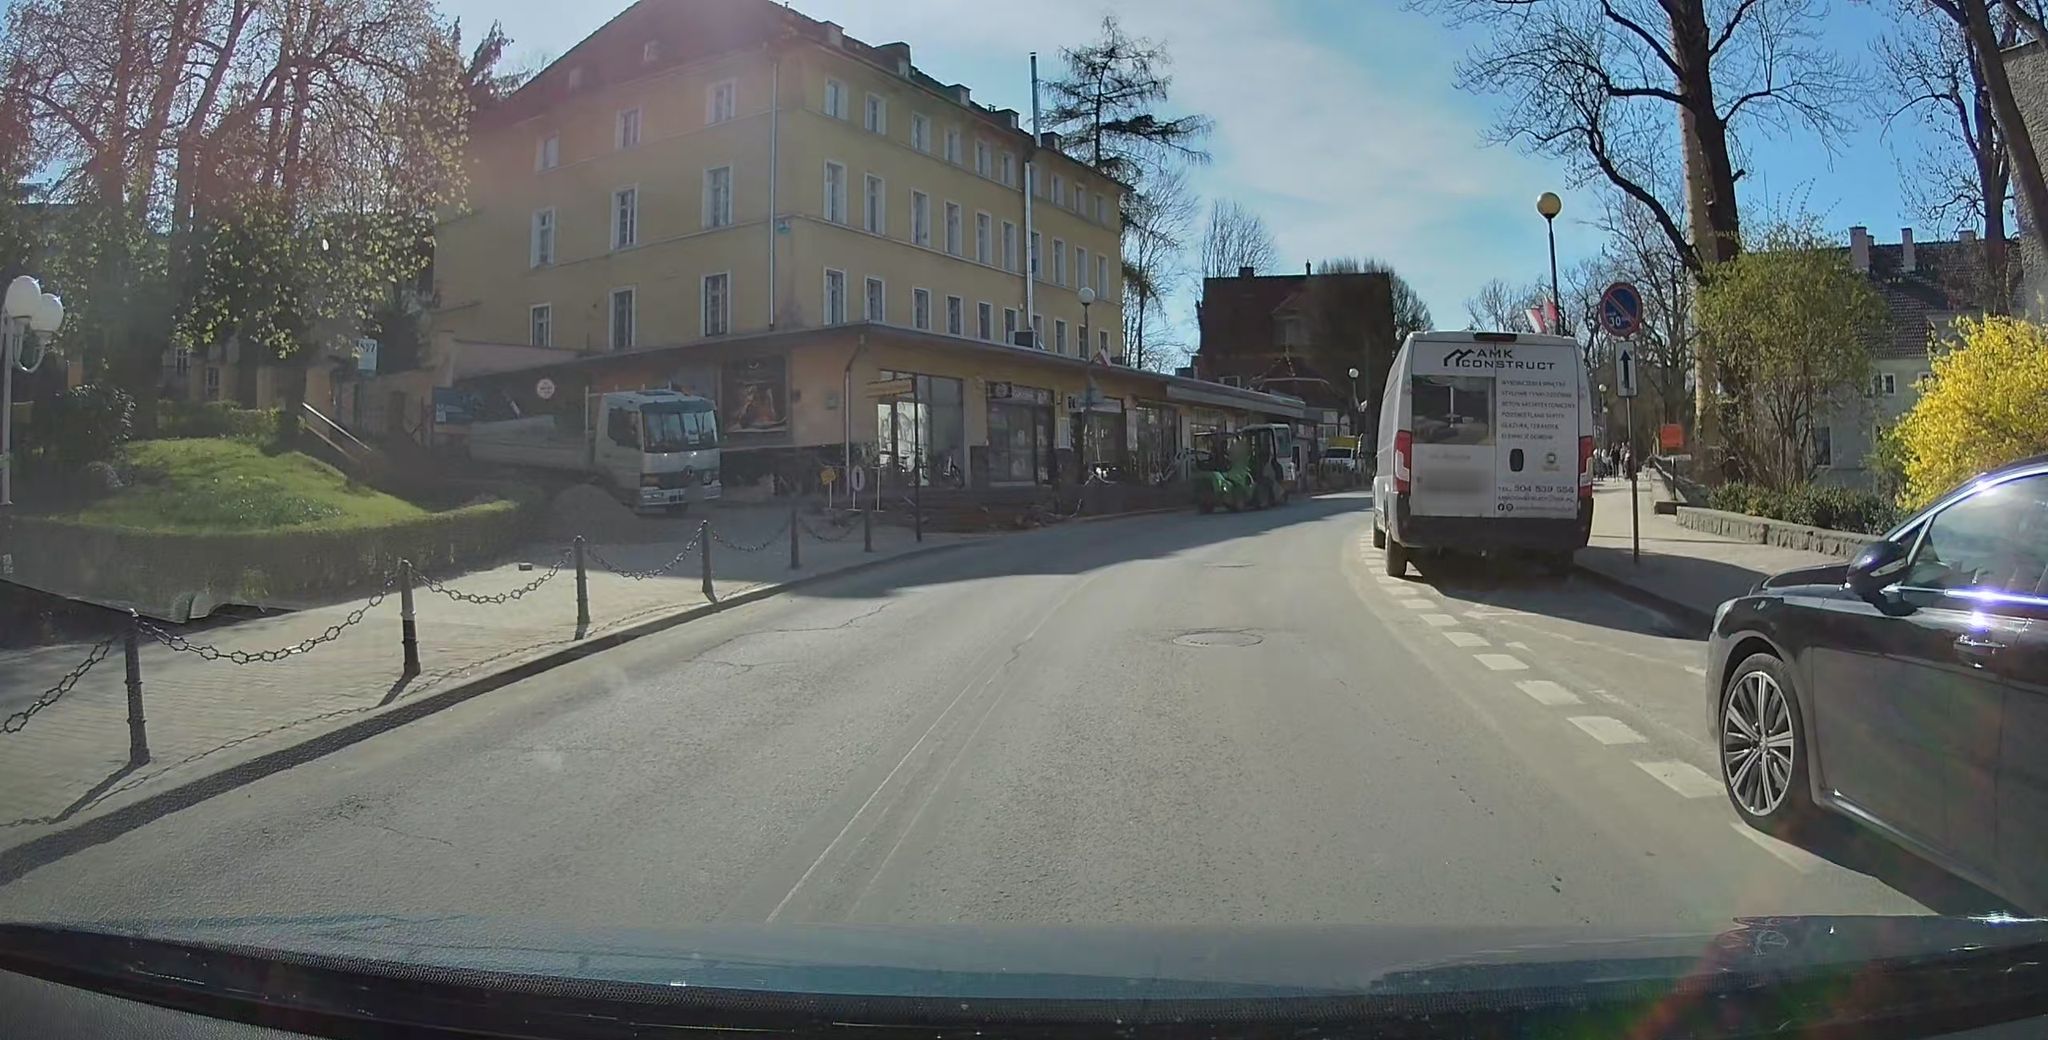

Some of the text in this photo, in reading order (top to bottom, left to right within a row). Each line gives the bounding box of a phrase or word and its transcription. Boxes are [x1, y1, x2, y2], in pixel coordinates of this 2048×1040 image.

[1608, 316, 1621, 327] 30
[1476, 348, 1513, 359] AMK
[1461, 359, 1556, 370] CONSTRUCT
